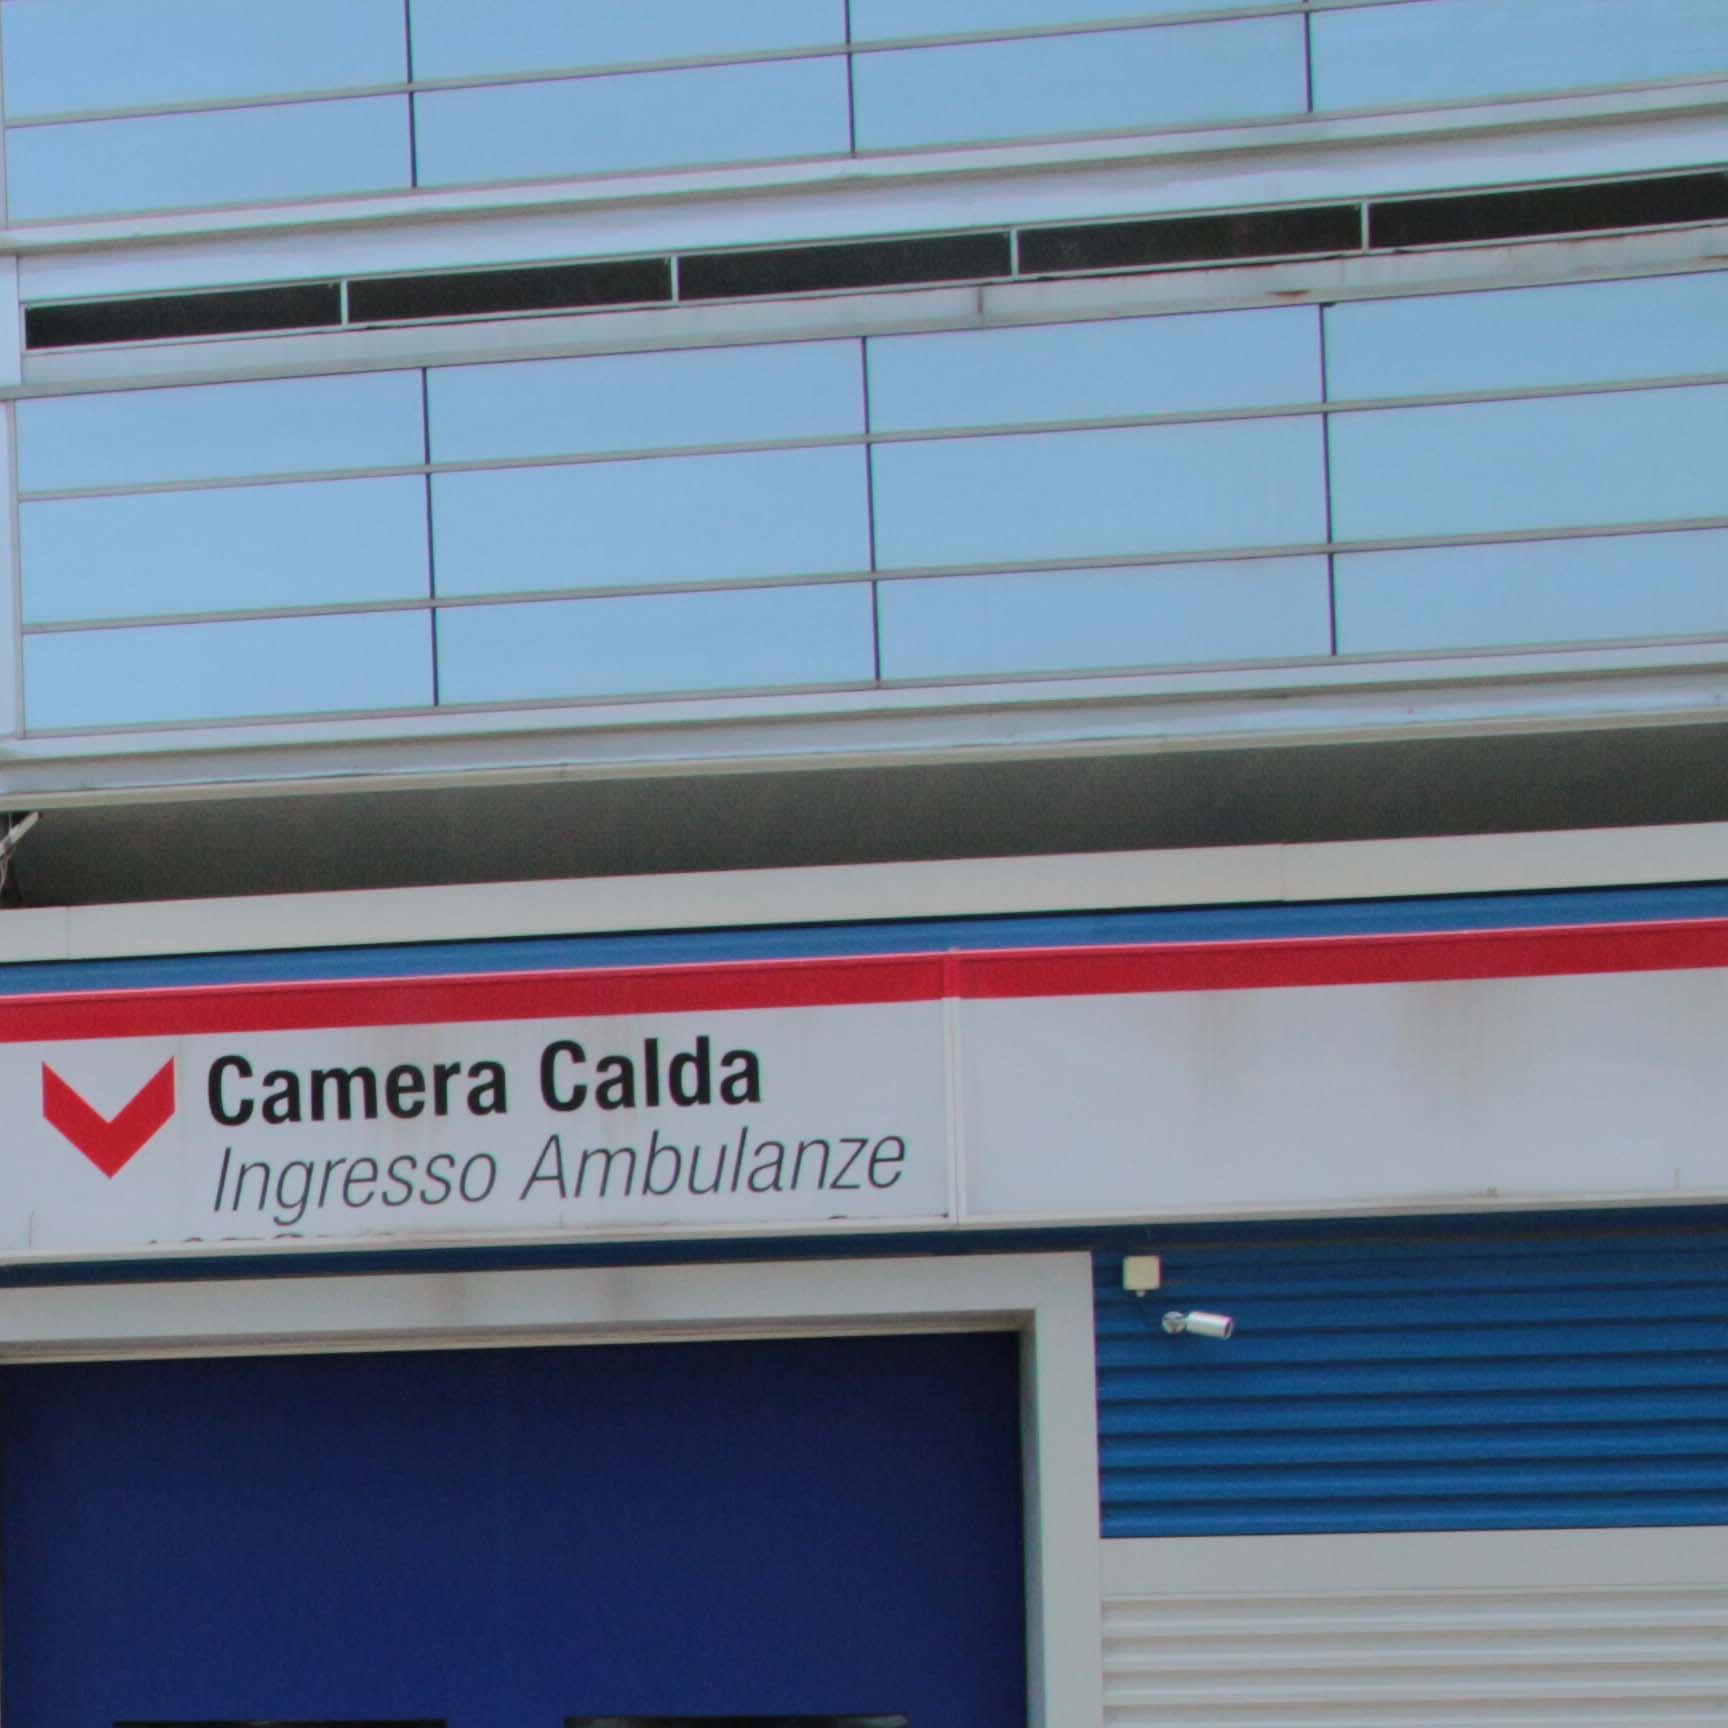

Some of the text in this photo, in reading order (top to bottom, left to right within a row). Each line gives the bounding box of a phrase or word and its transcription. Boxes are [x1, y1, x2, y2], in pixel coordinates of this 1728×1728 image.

[207, 1035, 761, 1126] Camera Calda
[213, 1126, 906, 1226] Ingresso Ambulanze
